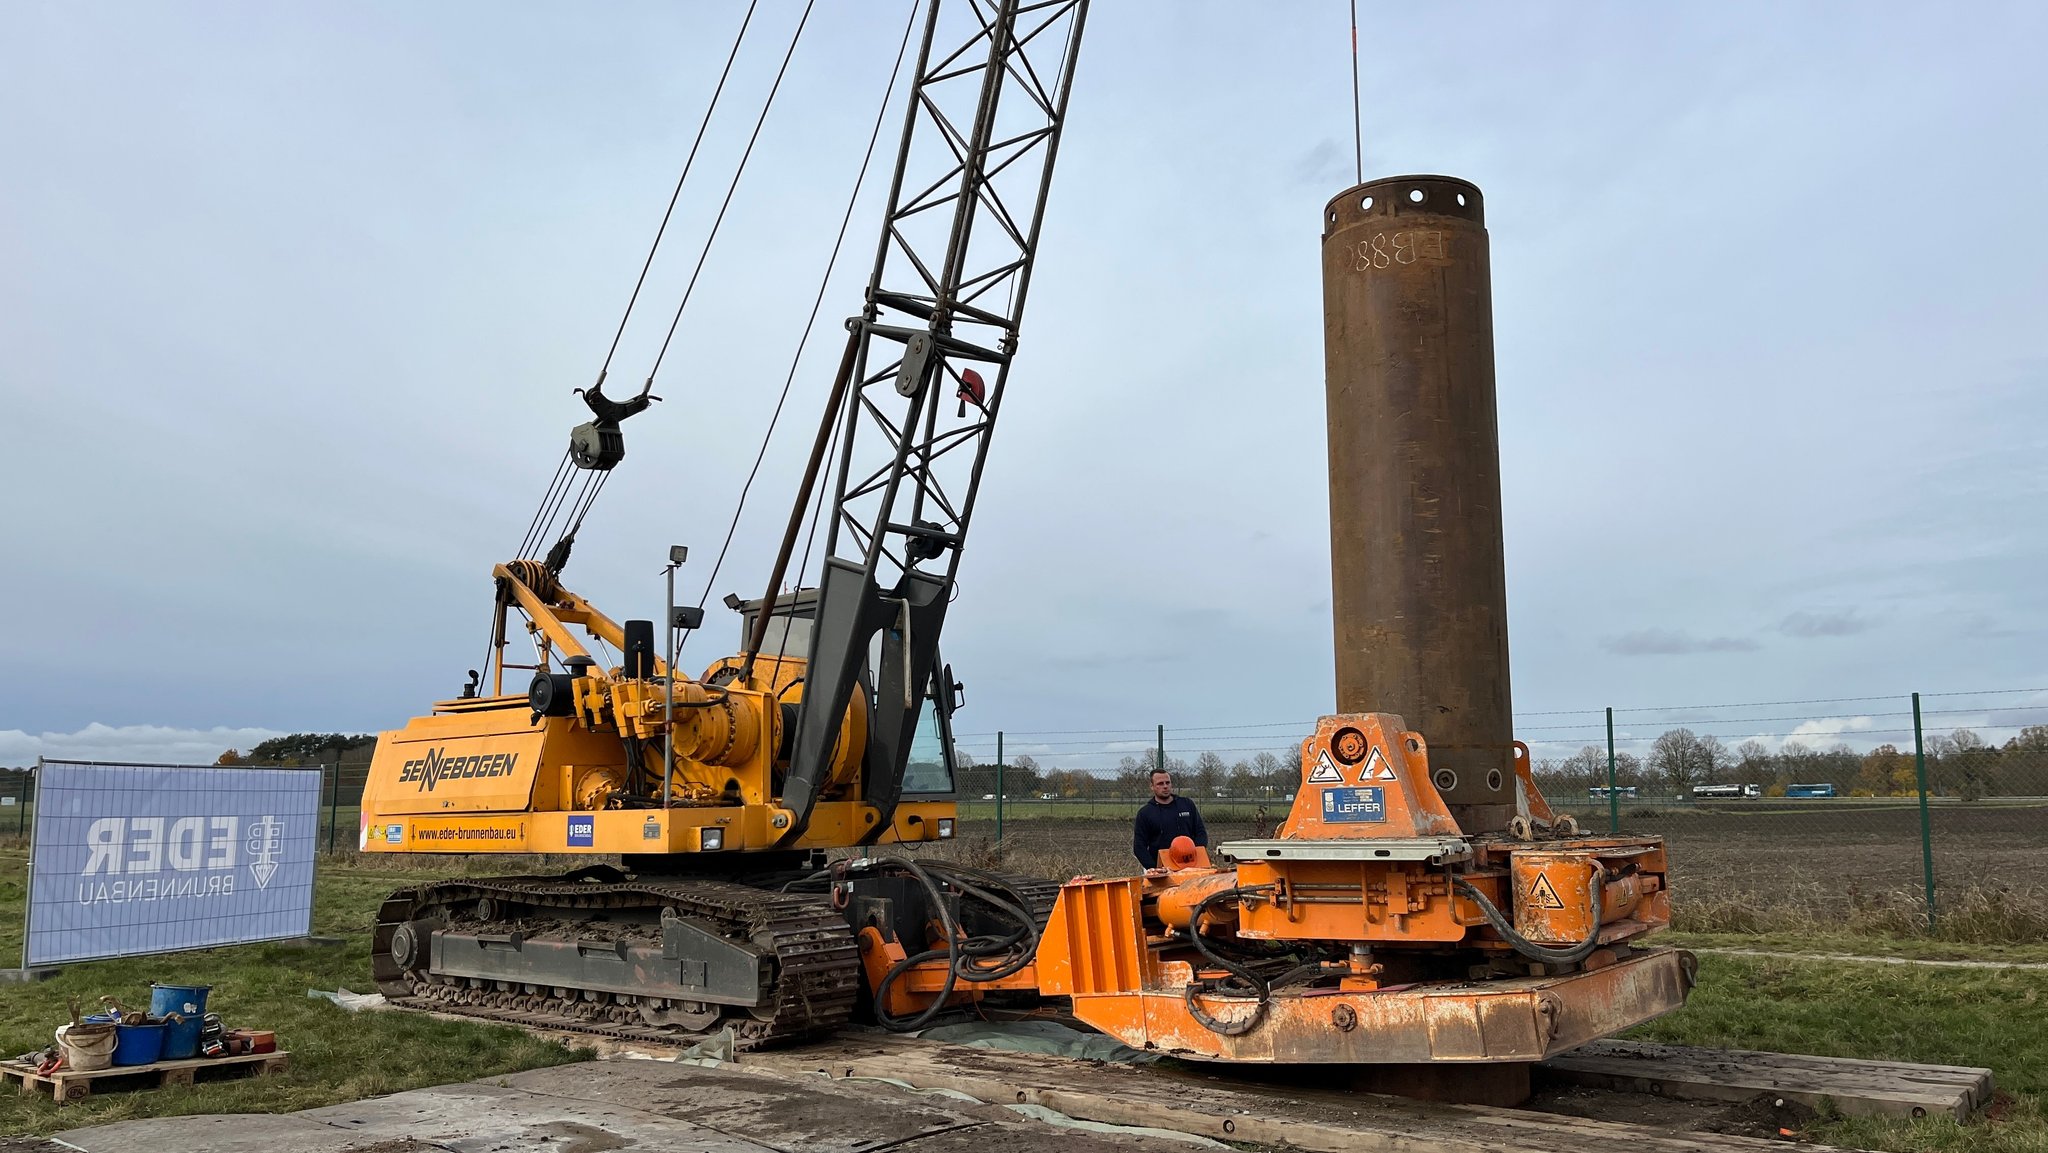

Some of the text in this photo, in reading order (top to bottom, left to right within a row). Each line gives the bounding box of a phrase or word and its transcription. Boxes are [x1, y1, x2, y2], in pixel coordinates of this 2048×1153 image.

[399, 747, 518, 793] SENNEBOGEN
[1338, 803, 1380, 813] LEFFER
[418, 827, 516, 841] www.eder-brunnenbau.eu
[575, 824, 592, 834] EDER
